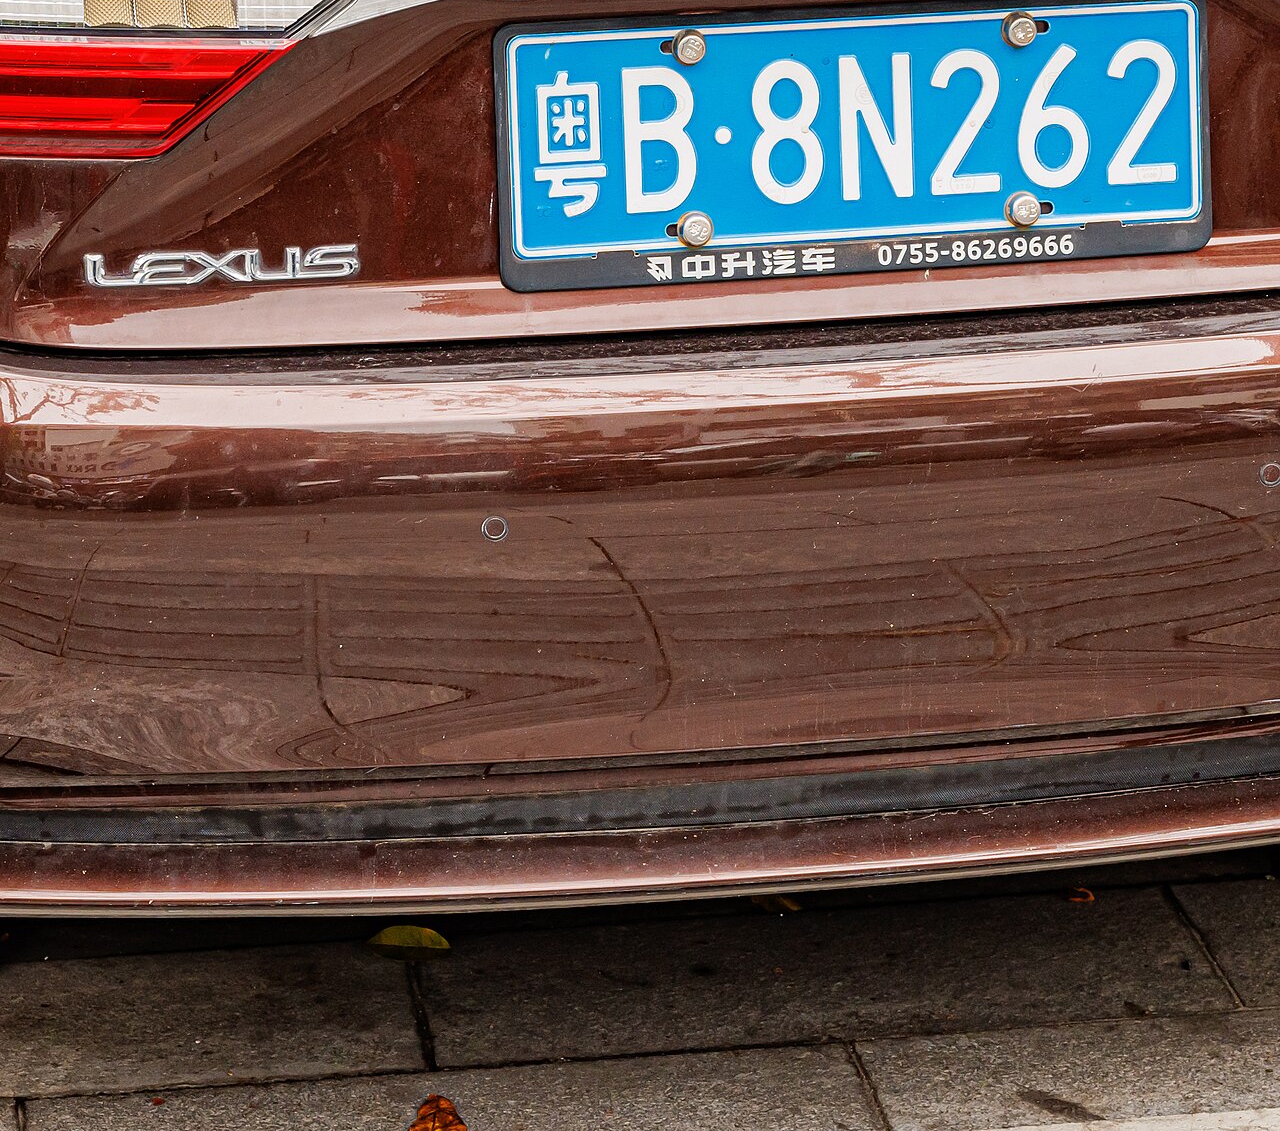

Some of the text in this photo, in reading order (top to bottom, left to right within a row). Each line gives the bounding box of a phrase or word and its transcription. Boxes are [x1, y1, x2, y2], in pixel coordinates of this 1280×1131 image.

[83, 244, 360, 287] LEXUS
[682, 234, 1075, 280] 中升汽车 0755-86269666
